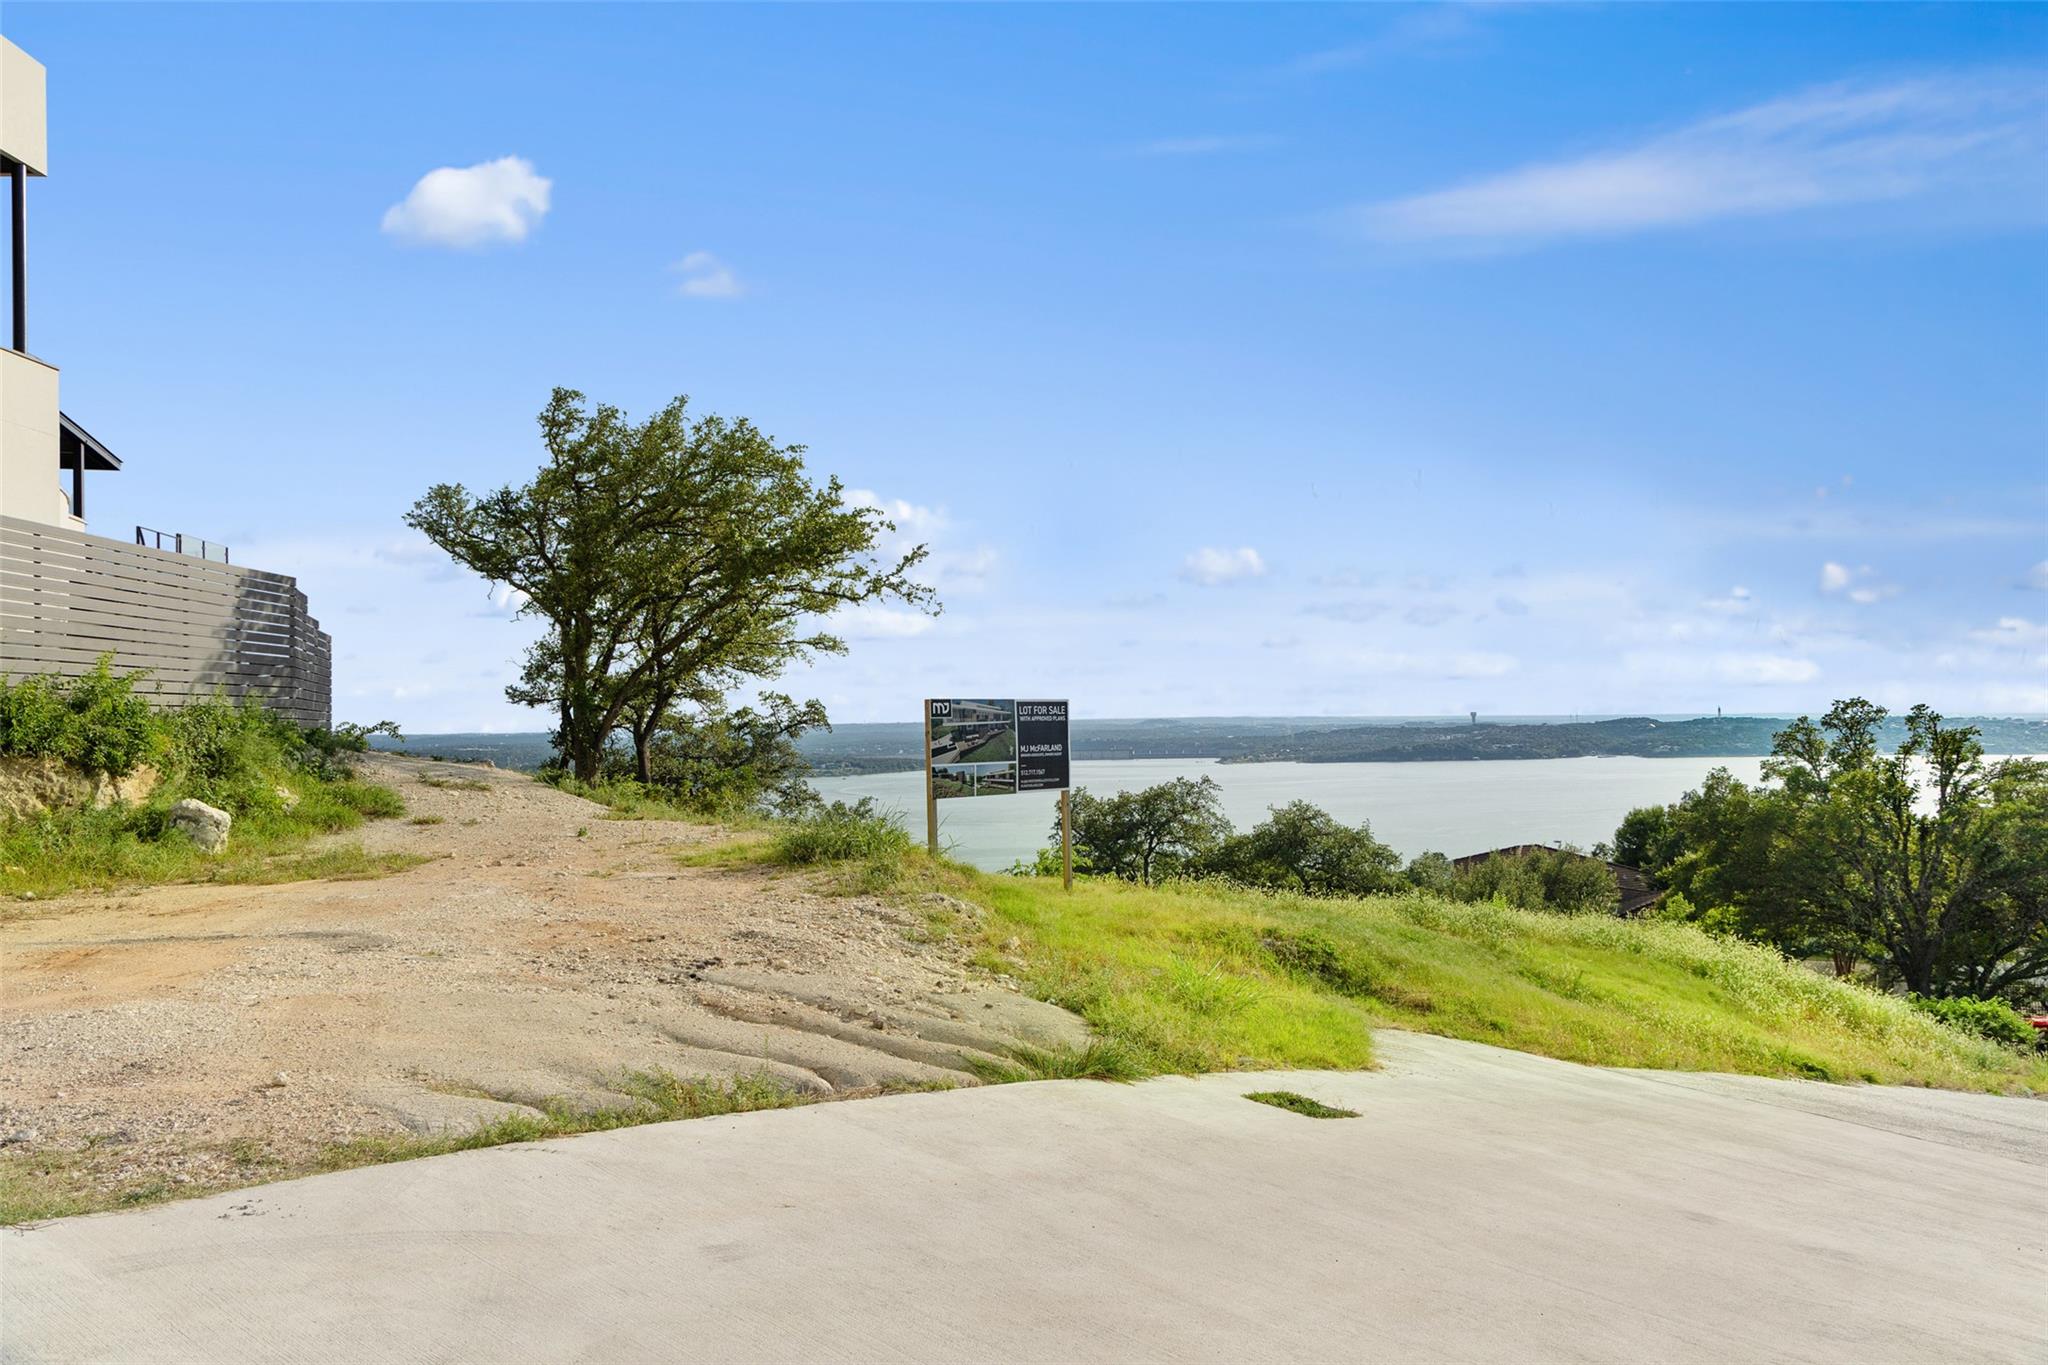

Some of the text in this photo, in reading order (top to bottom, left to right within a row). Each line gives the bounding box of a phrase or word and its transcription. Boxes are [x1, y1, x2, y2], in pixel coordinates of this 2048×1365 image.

[1019, 706, 1066, 715] LOT FOR SALE
[1030, 744, 1063, 752] McFARLAND
